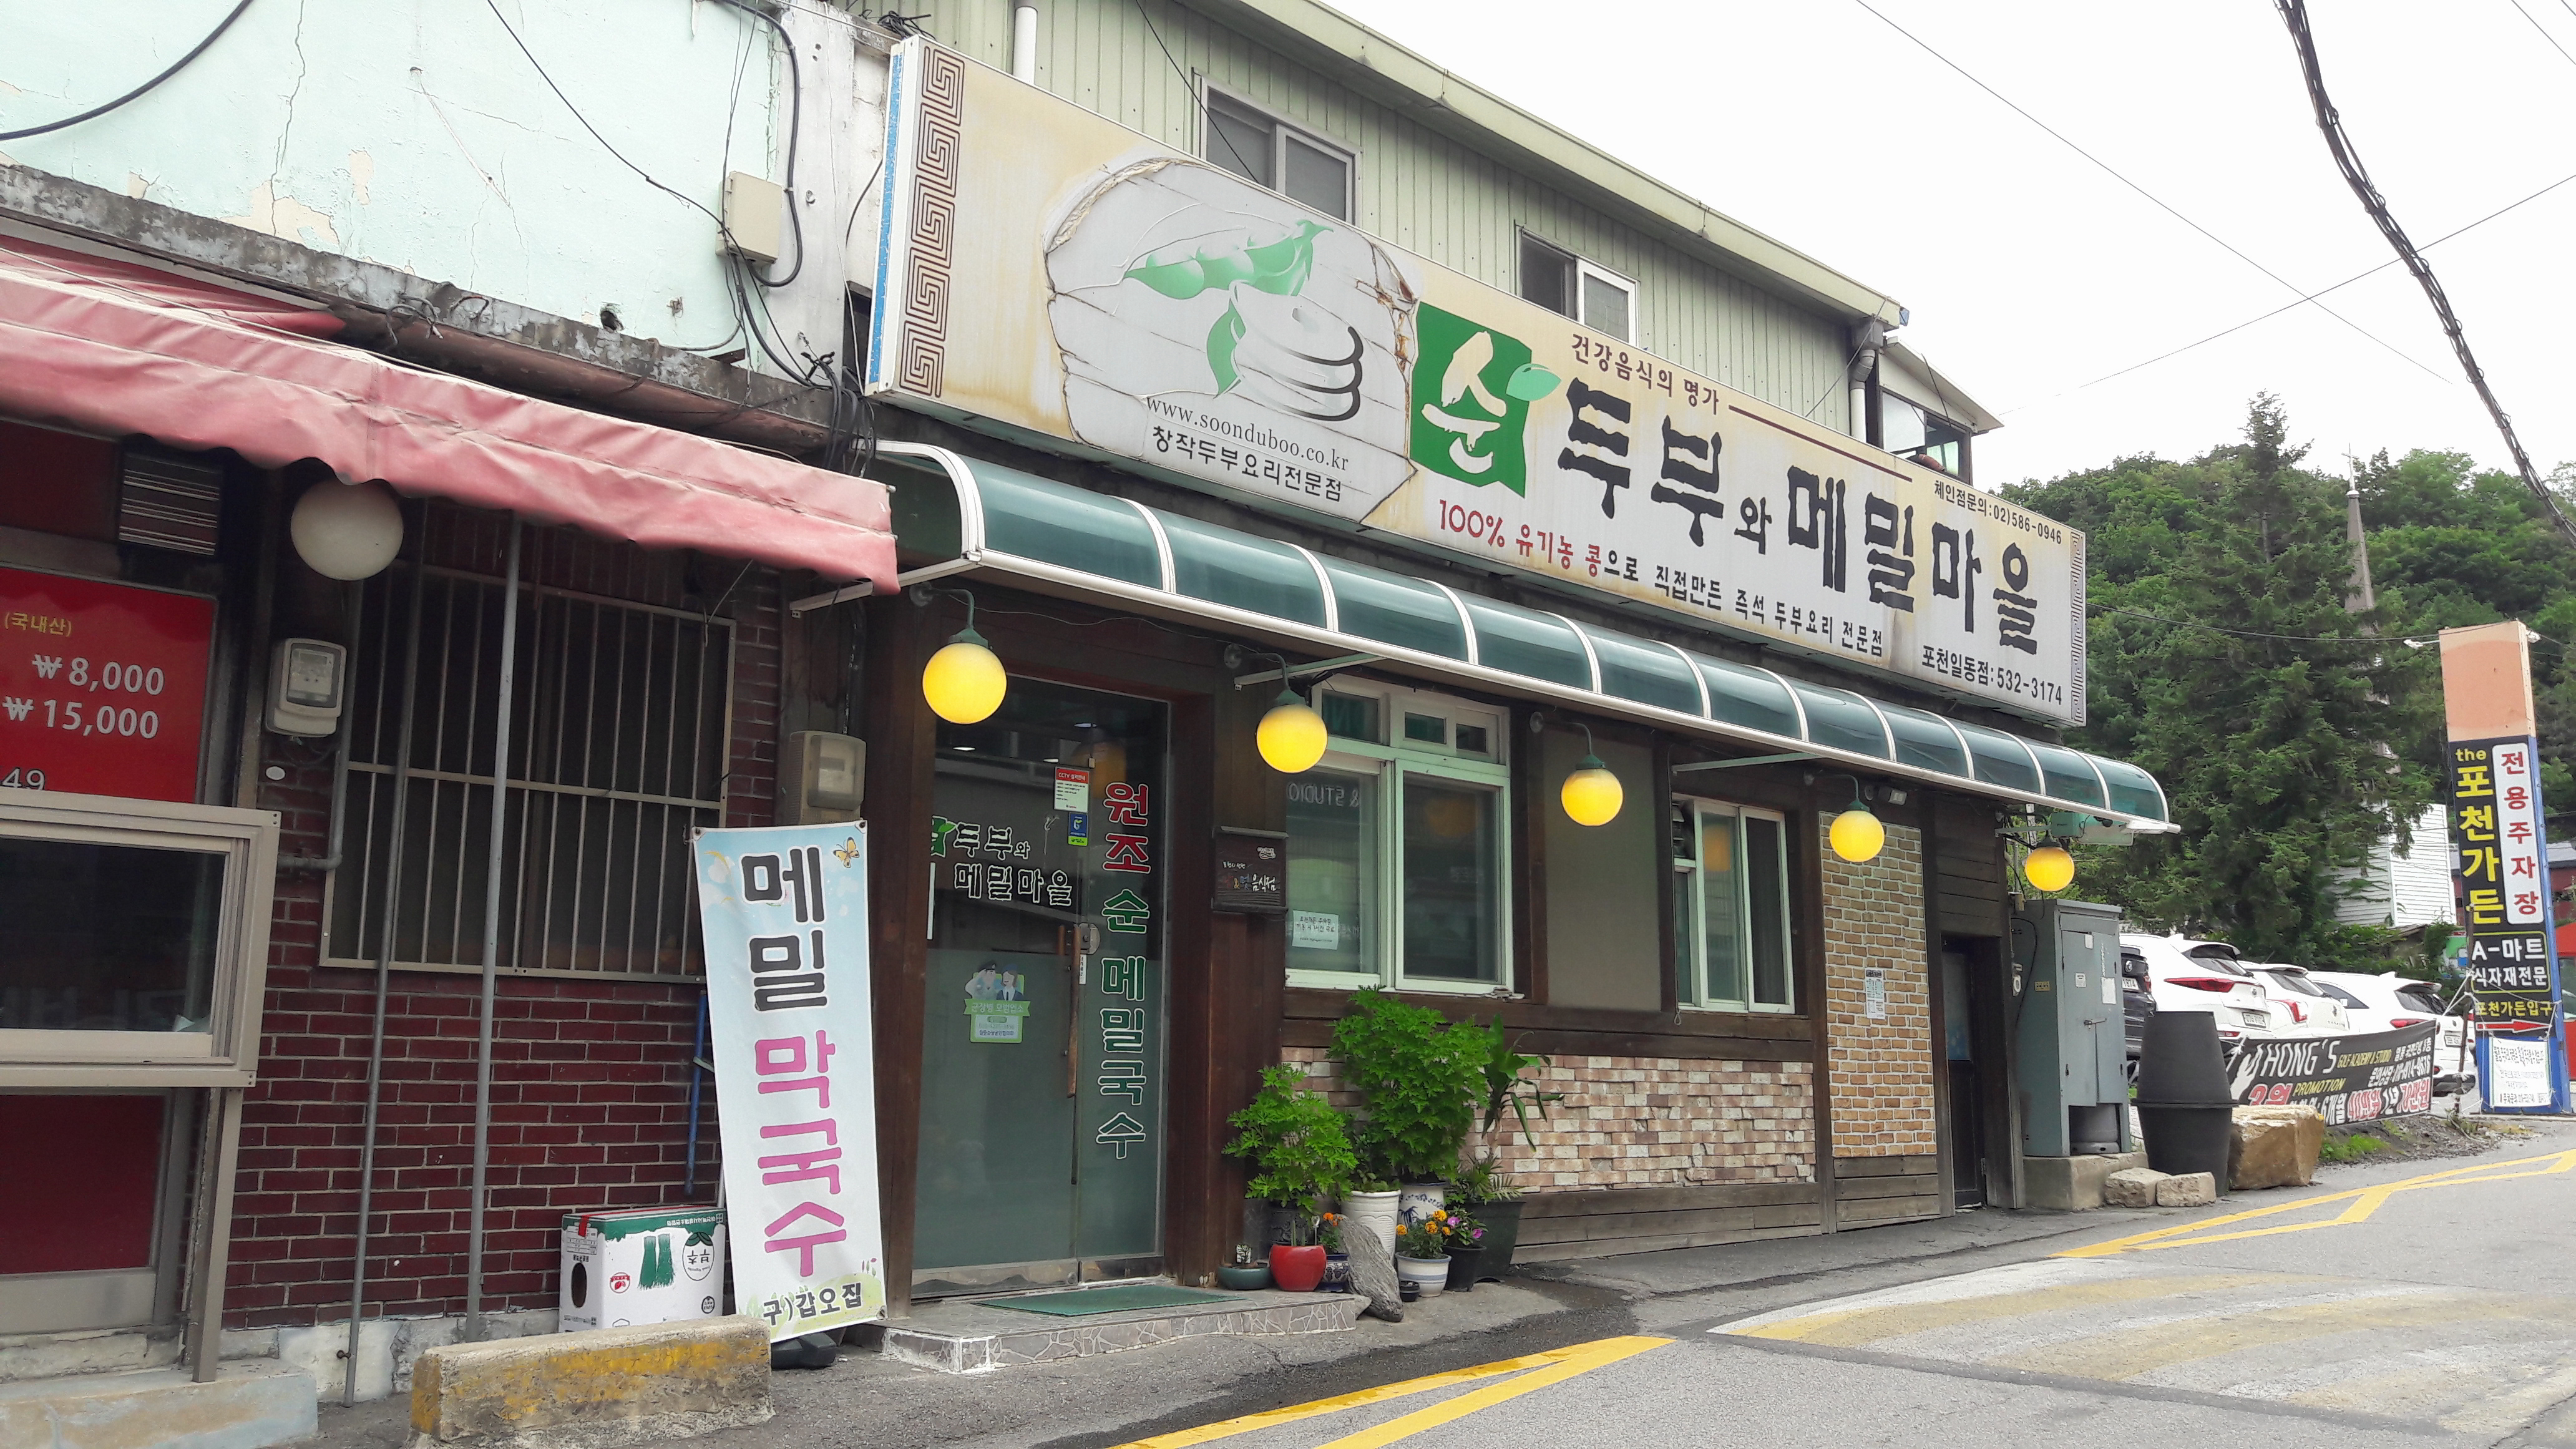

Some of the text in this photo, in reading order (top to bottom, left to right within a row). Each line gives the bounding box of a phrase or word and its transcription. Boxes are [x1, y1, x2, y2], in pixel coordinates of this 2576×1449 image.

[1571, 333, 1720, 415] 건강음식의 명가
[1146, 395, 1350, 471] www.soonduboo.co.kr
[1151, 424, 1343, 502] 창작두부요리전문점
[1439, 499, 1883, 658] 100% 유기농 콩으로 직접만든 즉석 두부요리 전문점
[1787, 464, 2038, 656] 메밀마을
[5, 612, 72, 638] (국내산)
[2455, 748, 2487, 762] the
[1102, 782, 1151, 874] 원조
[2456, 765, 2504, 924] 포천가든
[954, 862, 1073, 907] 메밀마을
[1251, 873, 1277, 893] 음식점
[2471, 938, 2545, 962] A-마트
[2474, 966, 2547, 987] 식자재전문
[2260, 1039, 2342, 1077] HONG'S
[2291, 1078, 2348, 1097] PROMOTION
[686, 1249, 710, 1265] 부추
